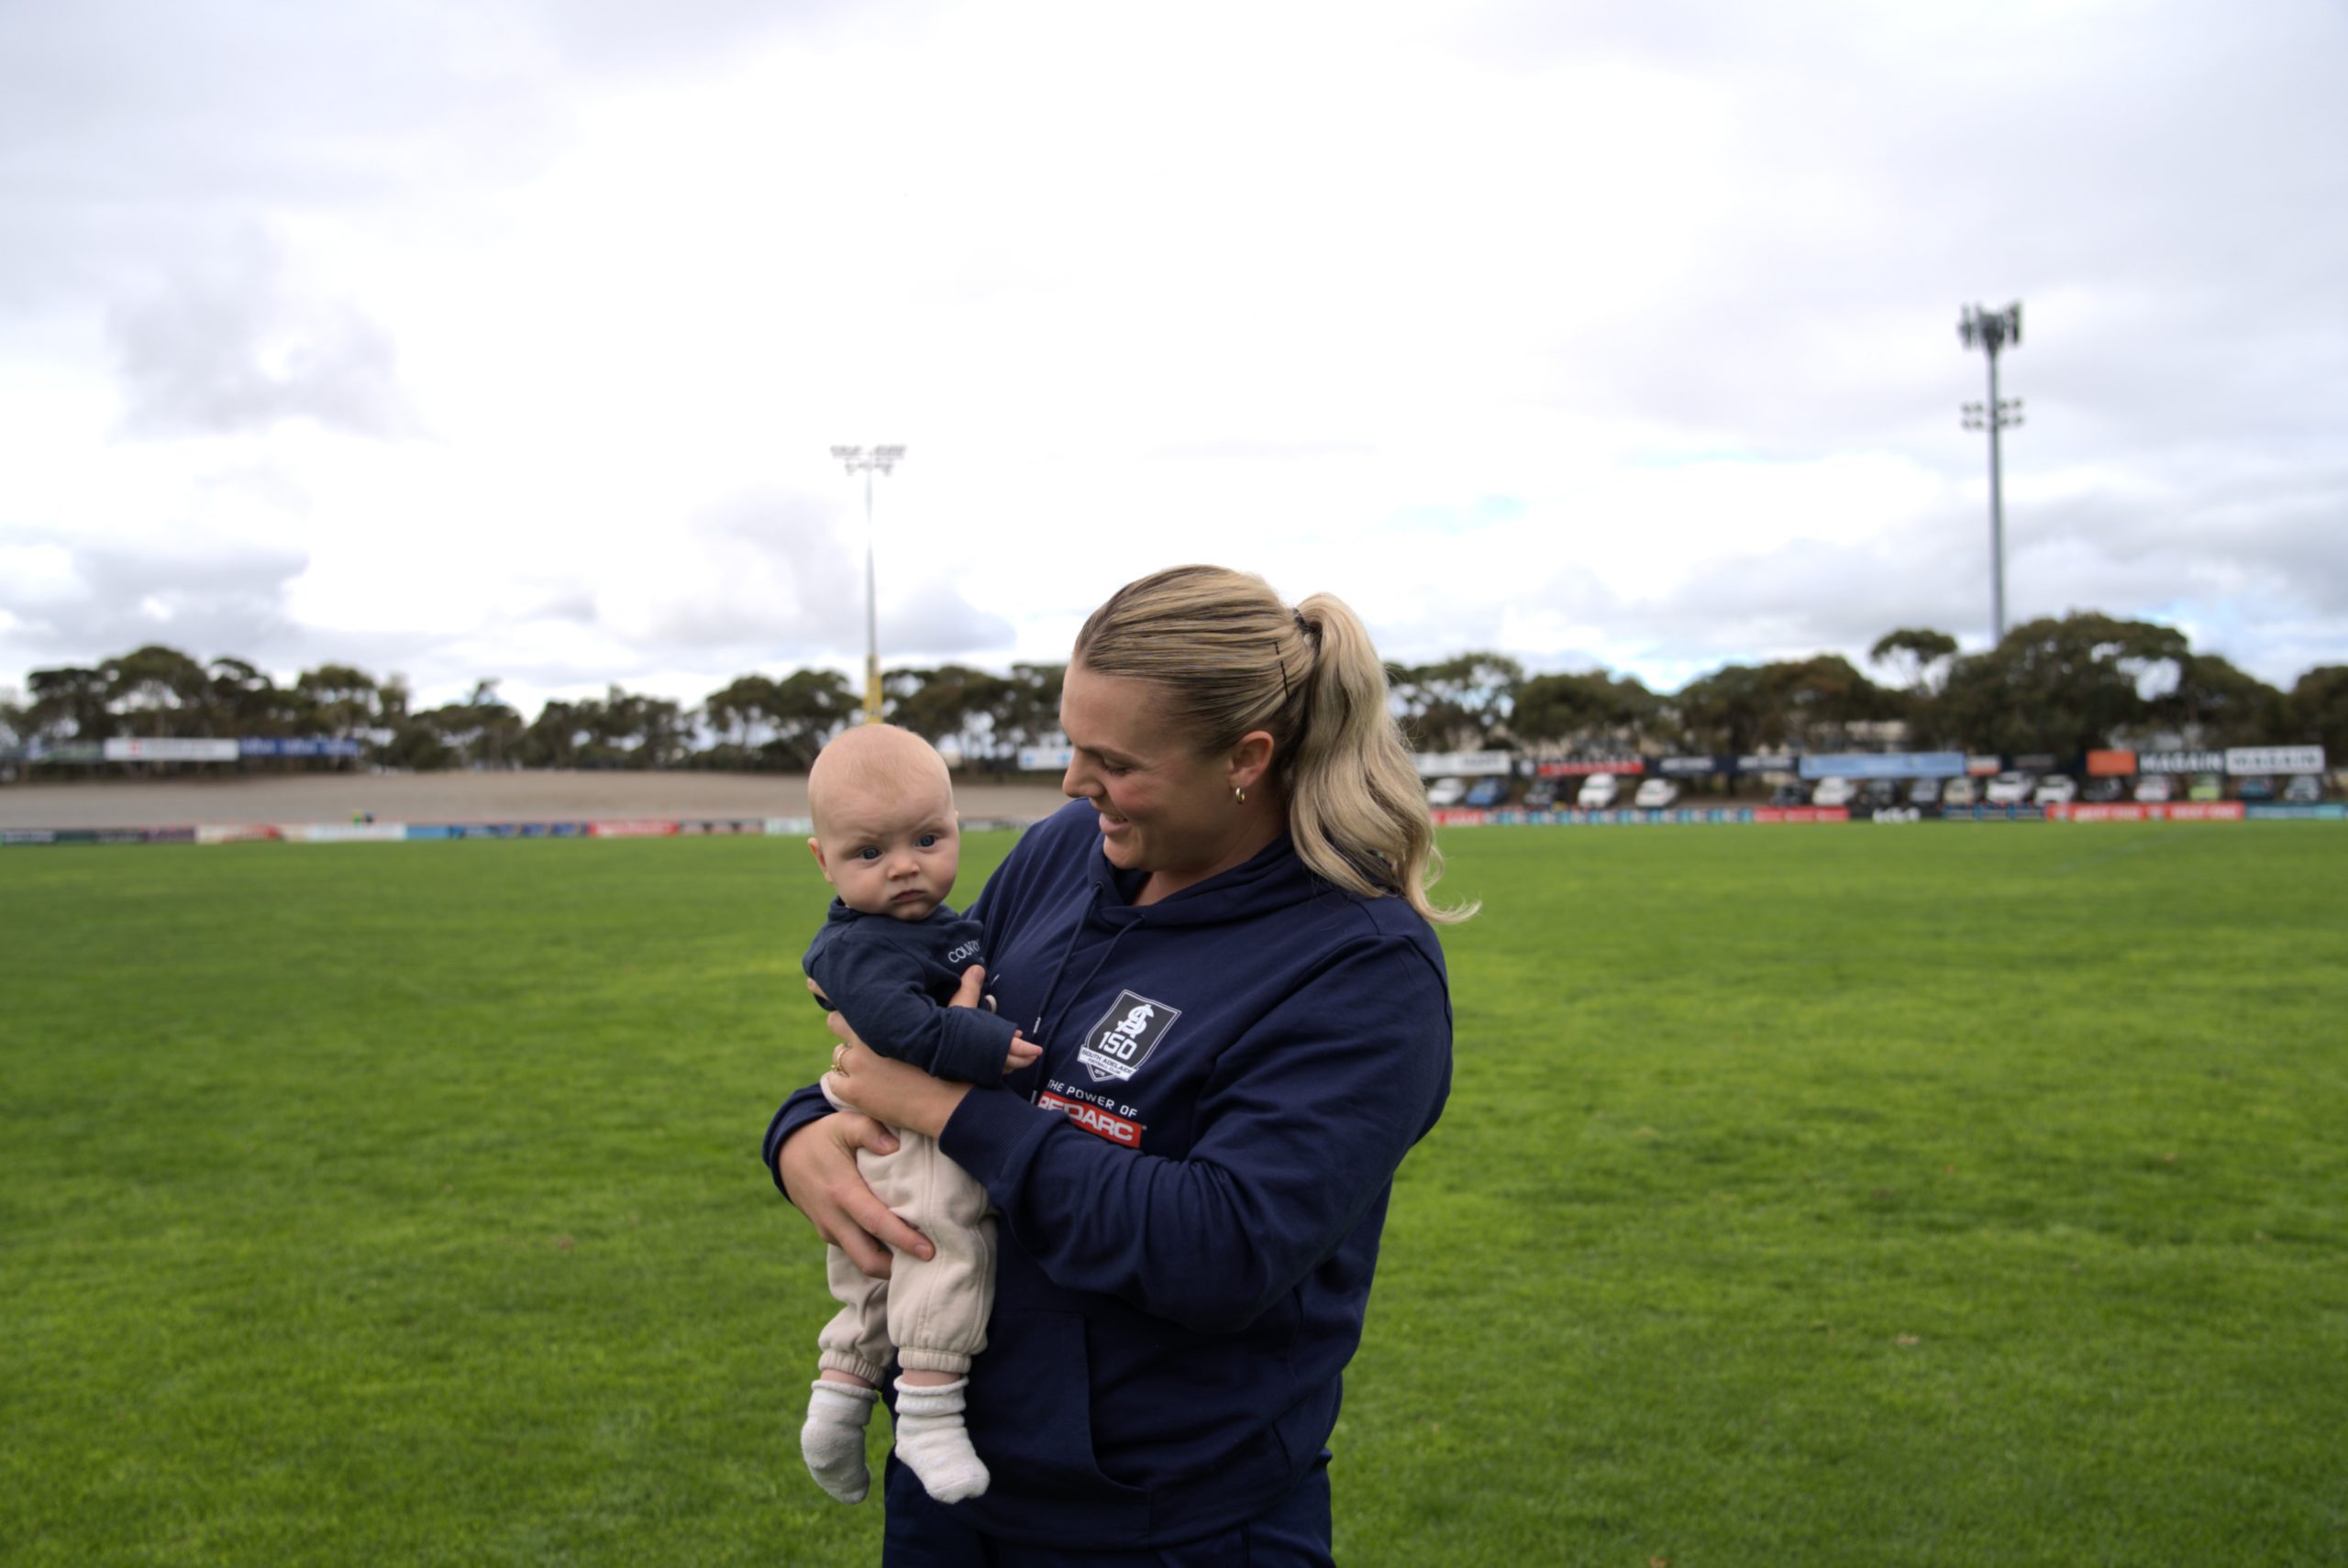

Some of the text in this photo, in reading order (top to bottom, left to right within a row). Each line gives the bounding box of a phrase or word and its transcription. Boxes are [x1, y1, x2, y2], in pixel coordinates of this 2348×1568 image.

[1081, 1048, 1102, 1062] SOUTH
[1098, 1031, 1137, 1061] 150
[1047, 1079, 1138, 1118] THE POWER OF
